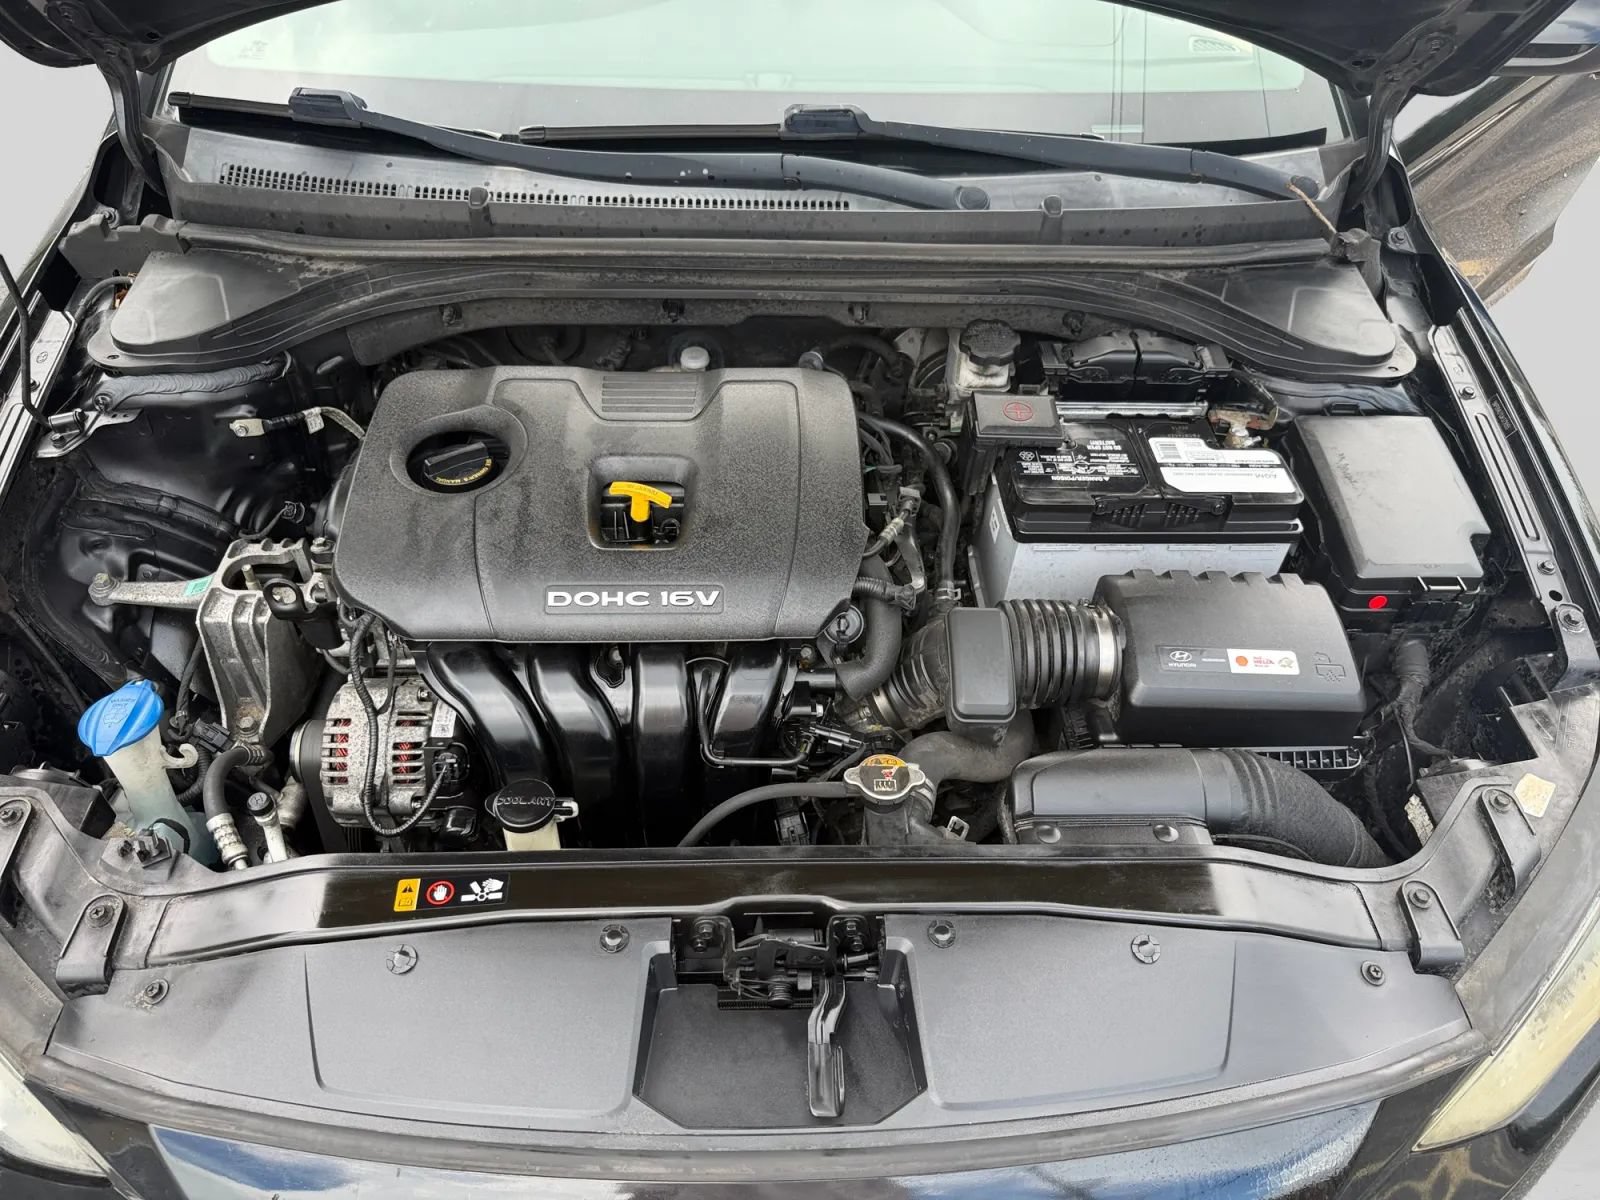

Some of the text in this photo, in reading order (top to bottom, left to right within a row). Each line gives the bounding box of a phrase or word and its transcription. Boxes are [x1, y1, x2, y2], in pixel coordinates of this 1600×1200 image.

[547, 590, 720, 607] DOHC 16V
[495, 796, 555, 807] COOLANT
